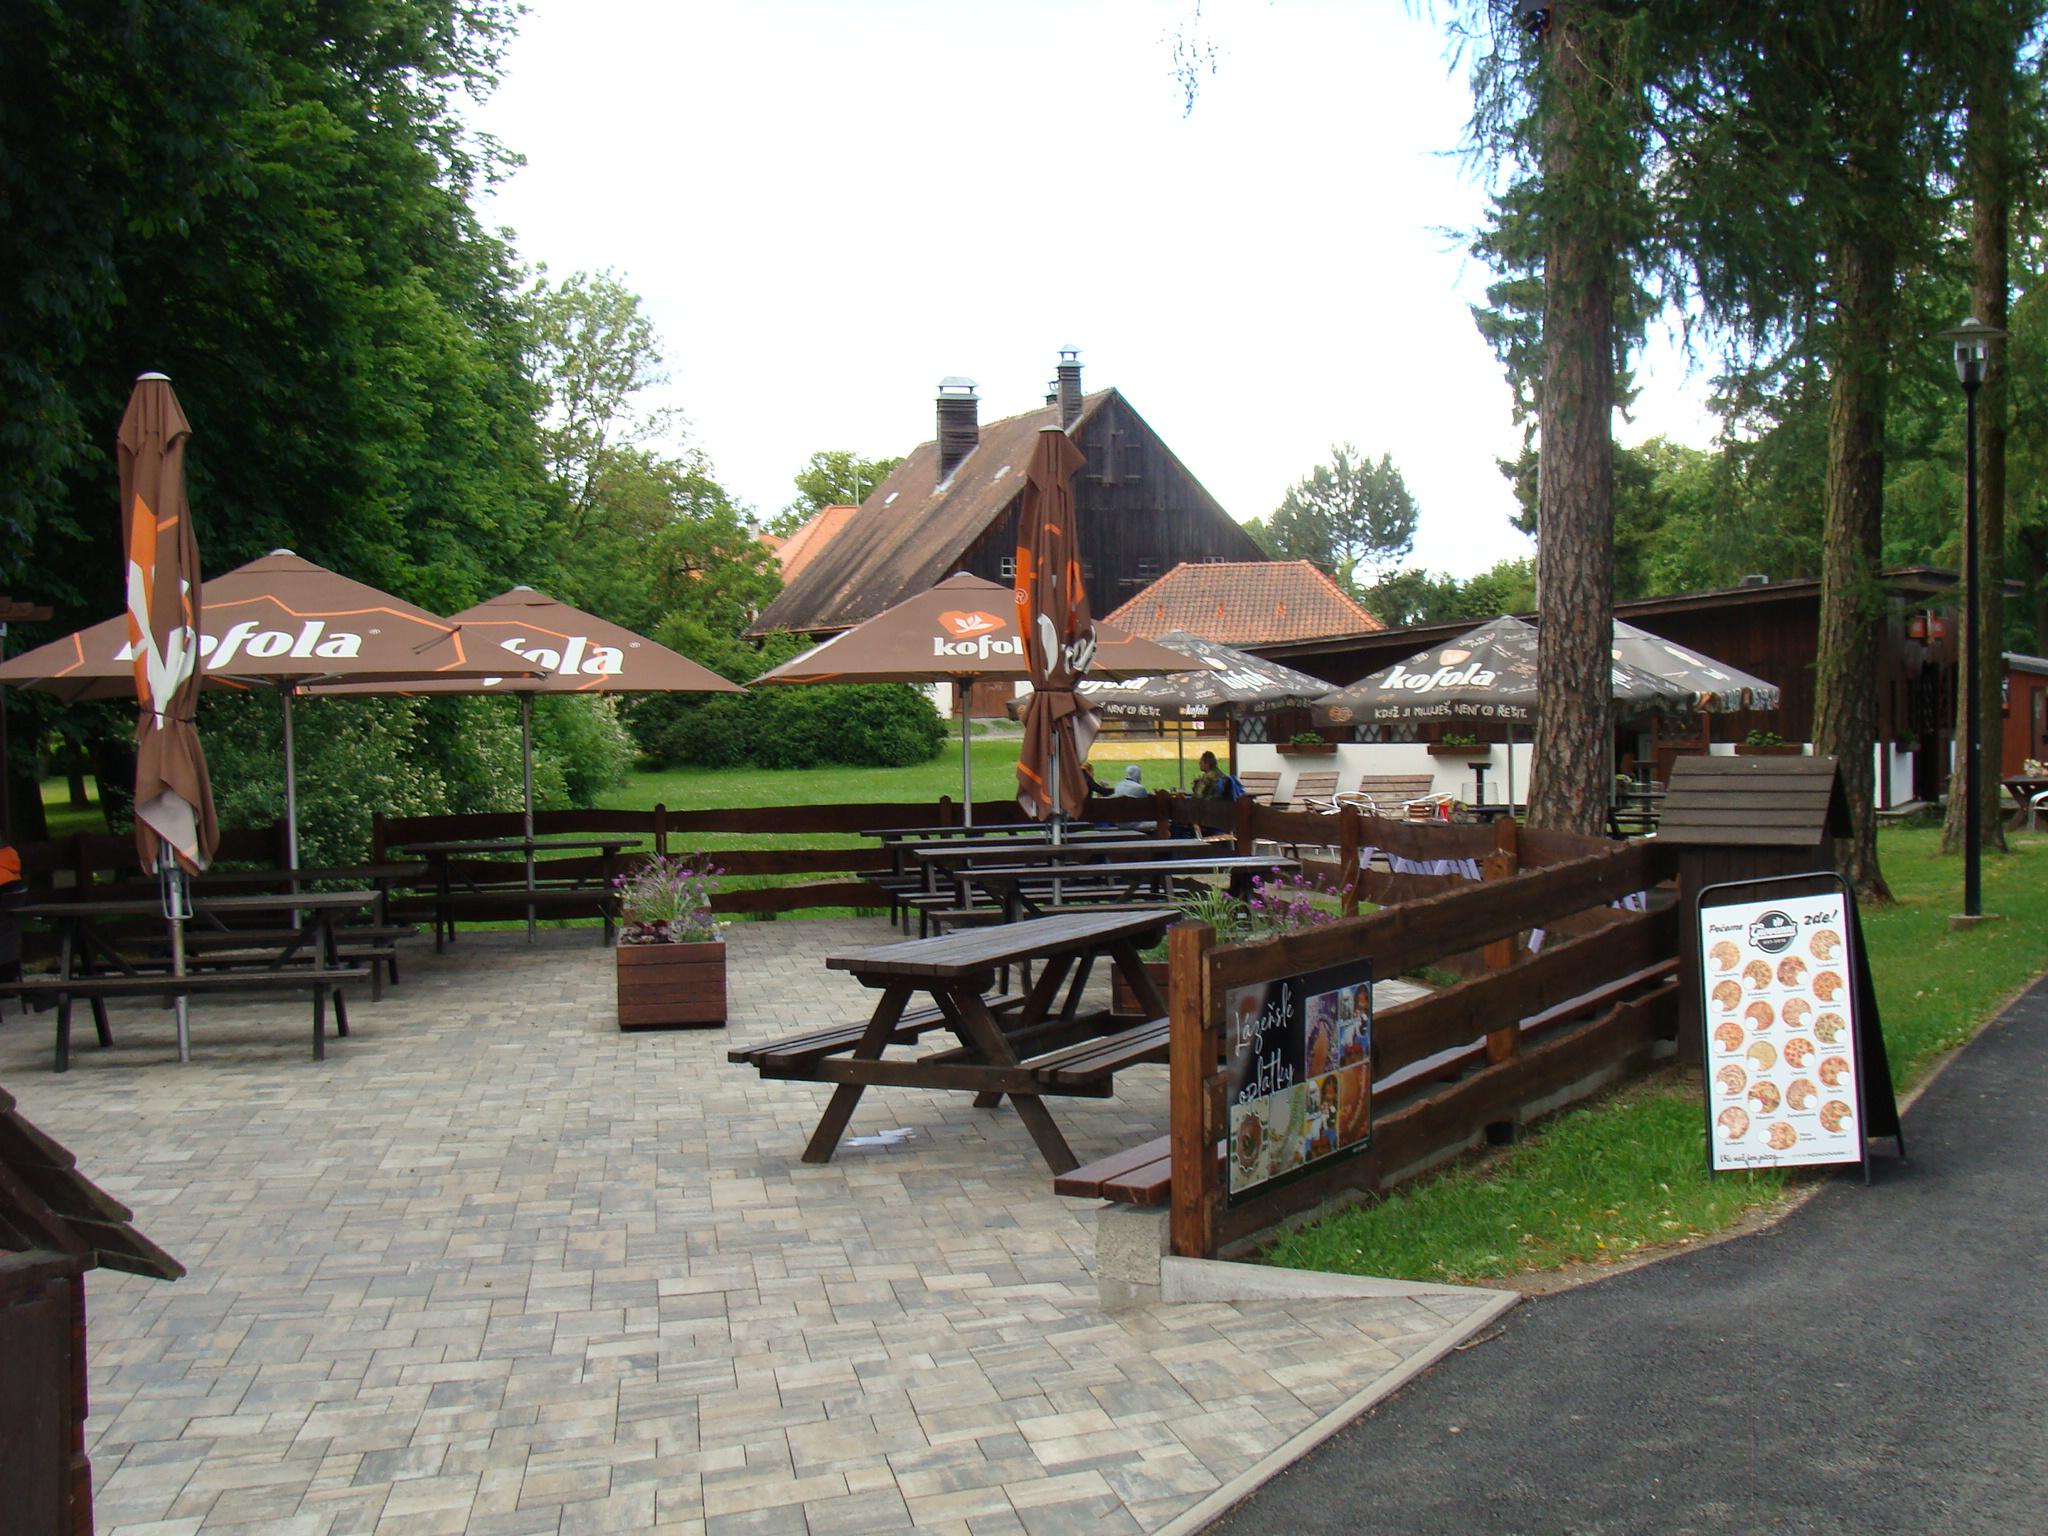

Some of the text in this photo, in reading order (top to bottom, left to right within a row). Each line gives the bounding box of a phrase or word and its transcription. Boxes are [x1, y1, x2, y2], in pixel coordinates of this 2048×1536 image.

[114, 621, 363, 670] fola
[500, 637, 624, 675] ola
[933, 634, 1024, 660] kofol
[1379, 663, 1497, 693] kofola
[1804, 909, 1838, 926] zde!
